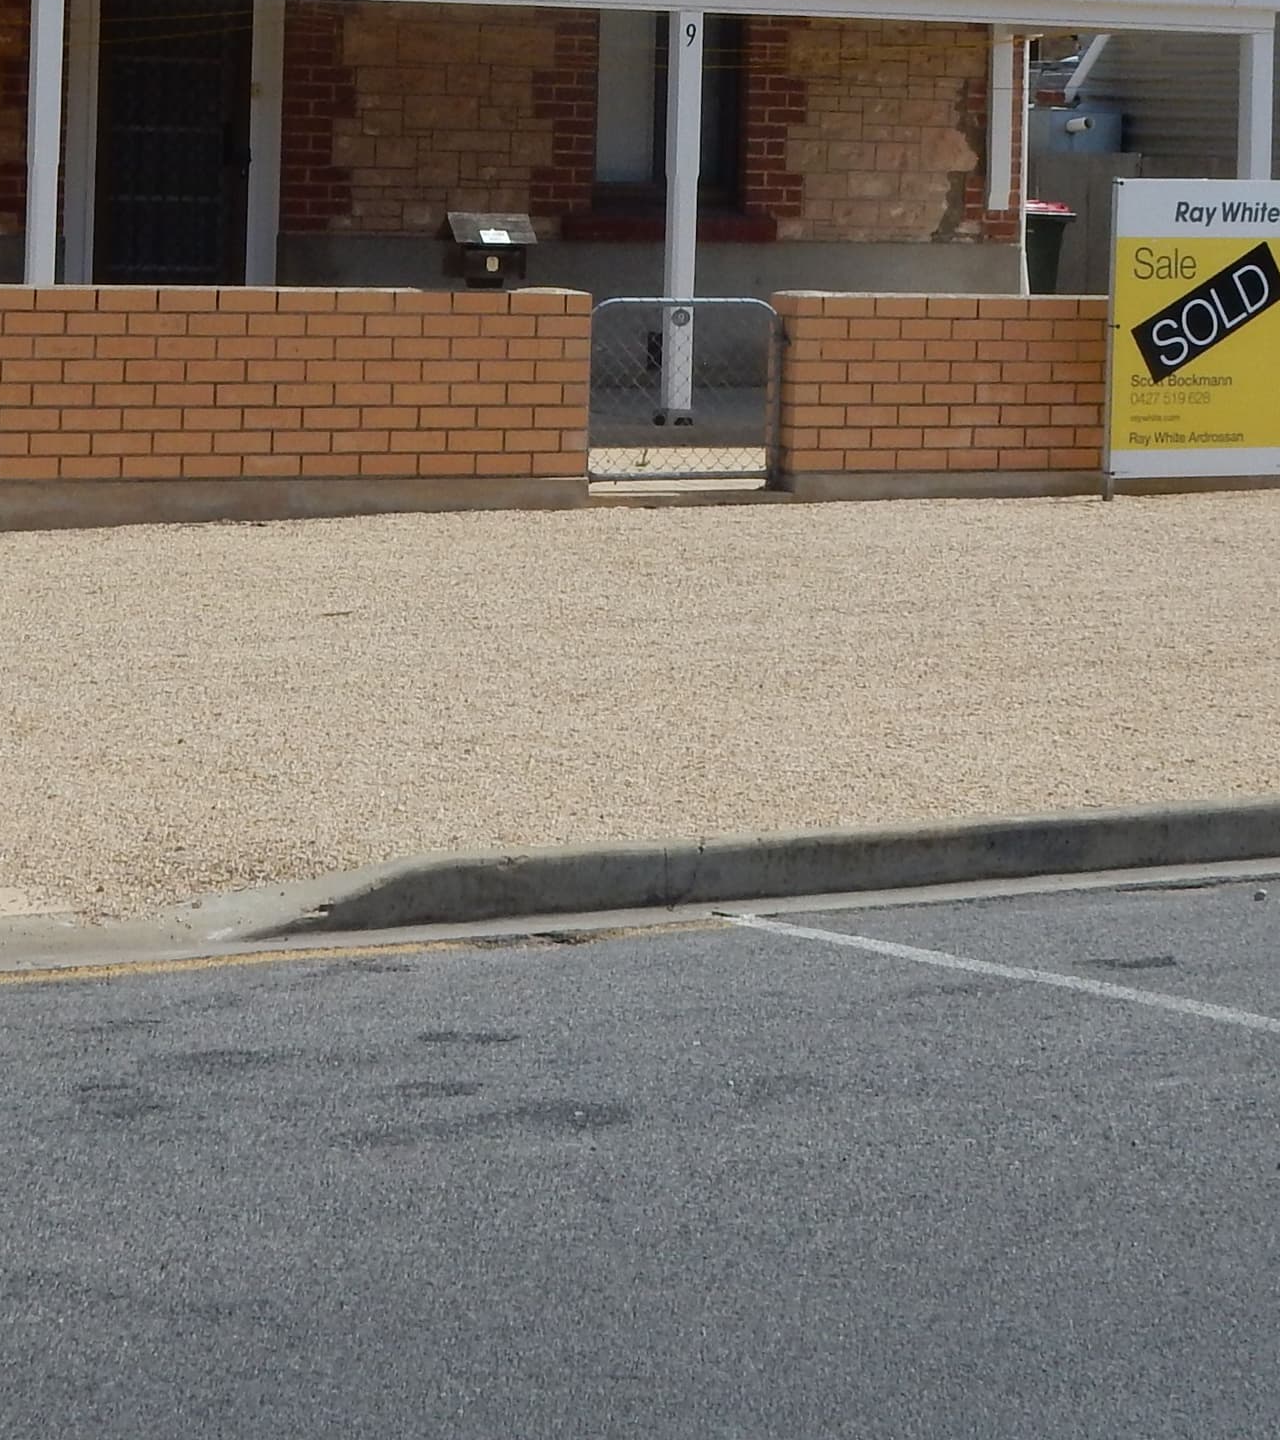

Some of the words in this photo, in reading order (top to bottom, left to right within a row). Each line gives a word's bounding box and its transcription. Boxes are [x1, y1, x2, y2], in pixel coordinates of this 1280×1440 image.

[686, 23, 696, 47] 9
[1175, 201, 1217, 227] Ray
[1222, 201, 1280, 223] White
[1134, 247, 1197, 280] Sale
[1151, 264, 1269, 367] SOLD
[1167, 374, 1232, 387] Bockmann
[1130, 391, 1160, 405] 0427
[1163, 391, 1186, 405] 519
[1129, 431, 1151, 447] Ray
[1154, 431, 1186, 444] White
[1188, 431, 1244, 444] Ardrossan
